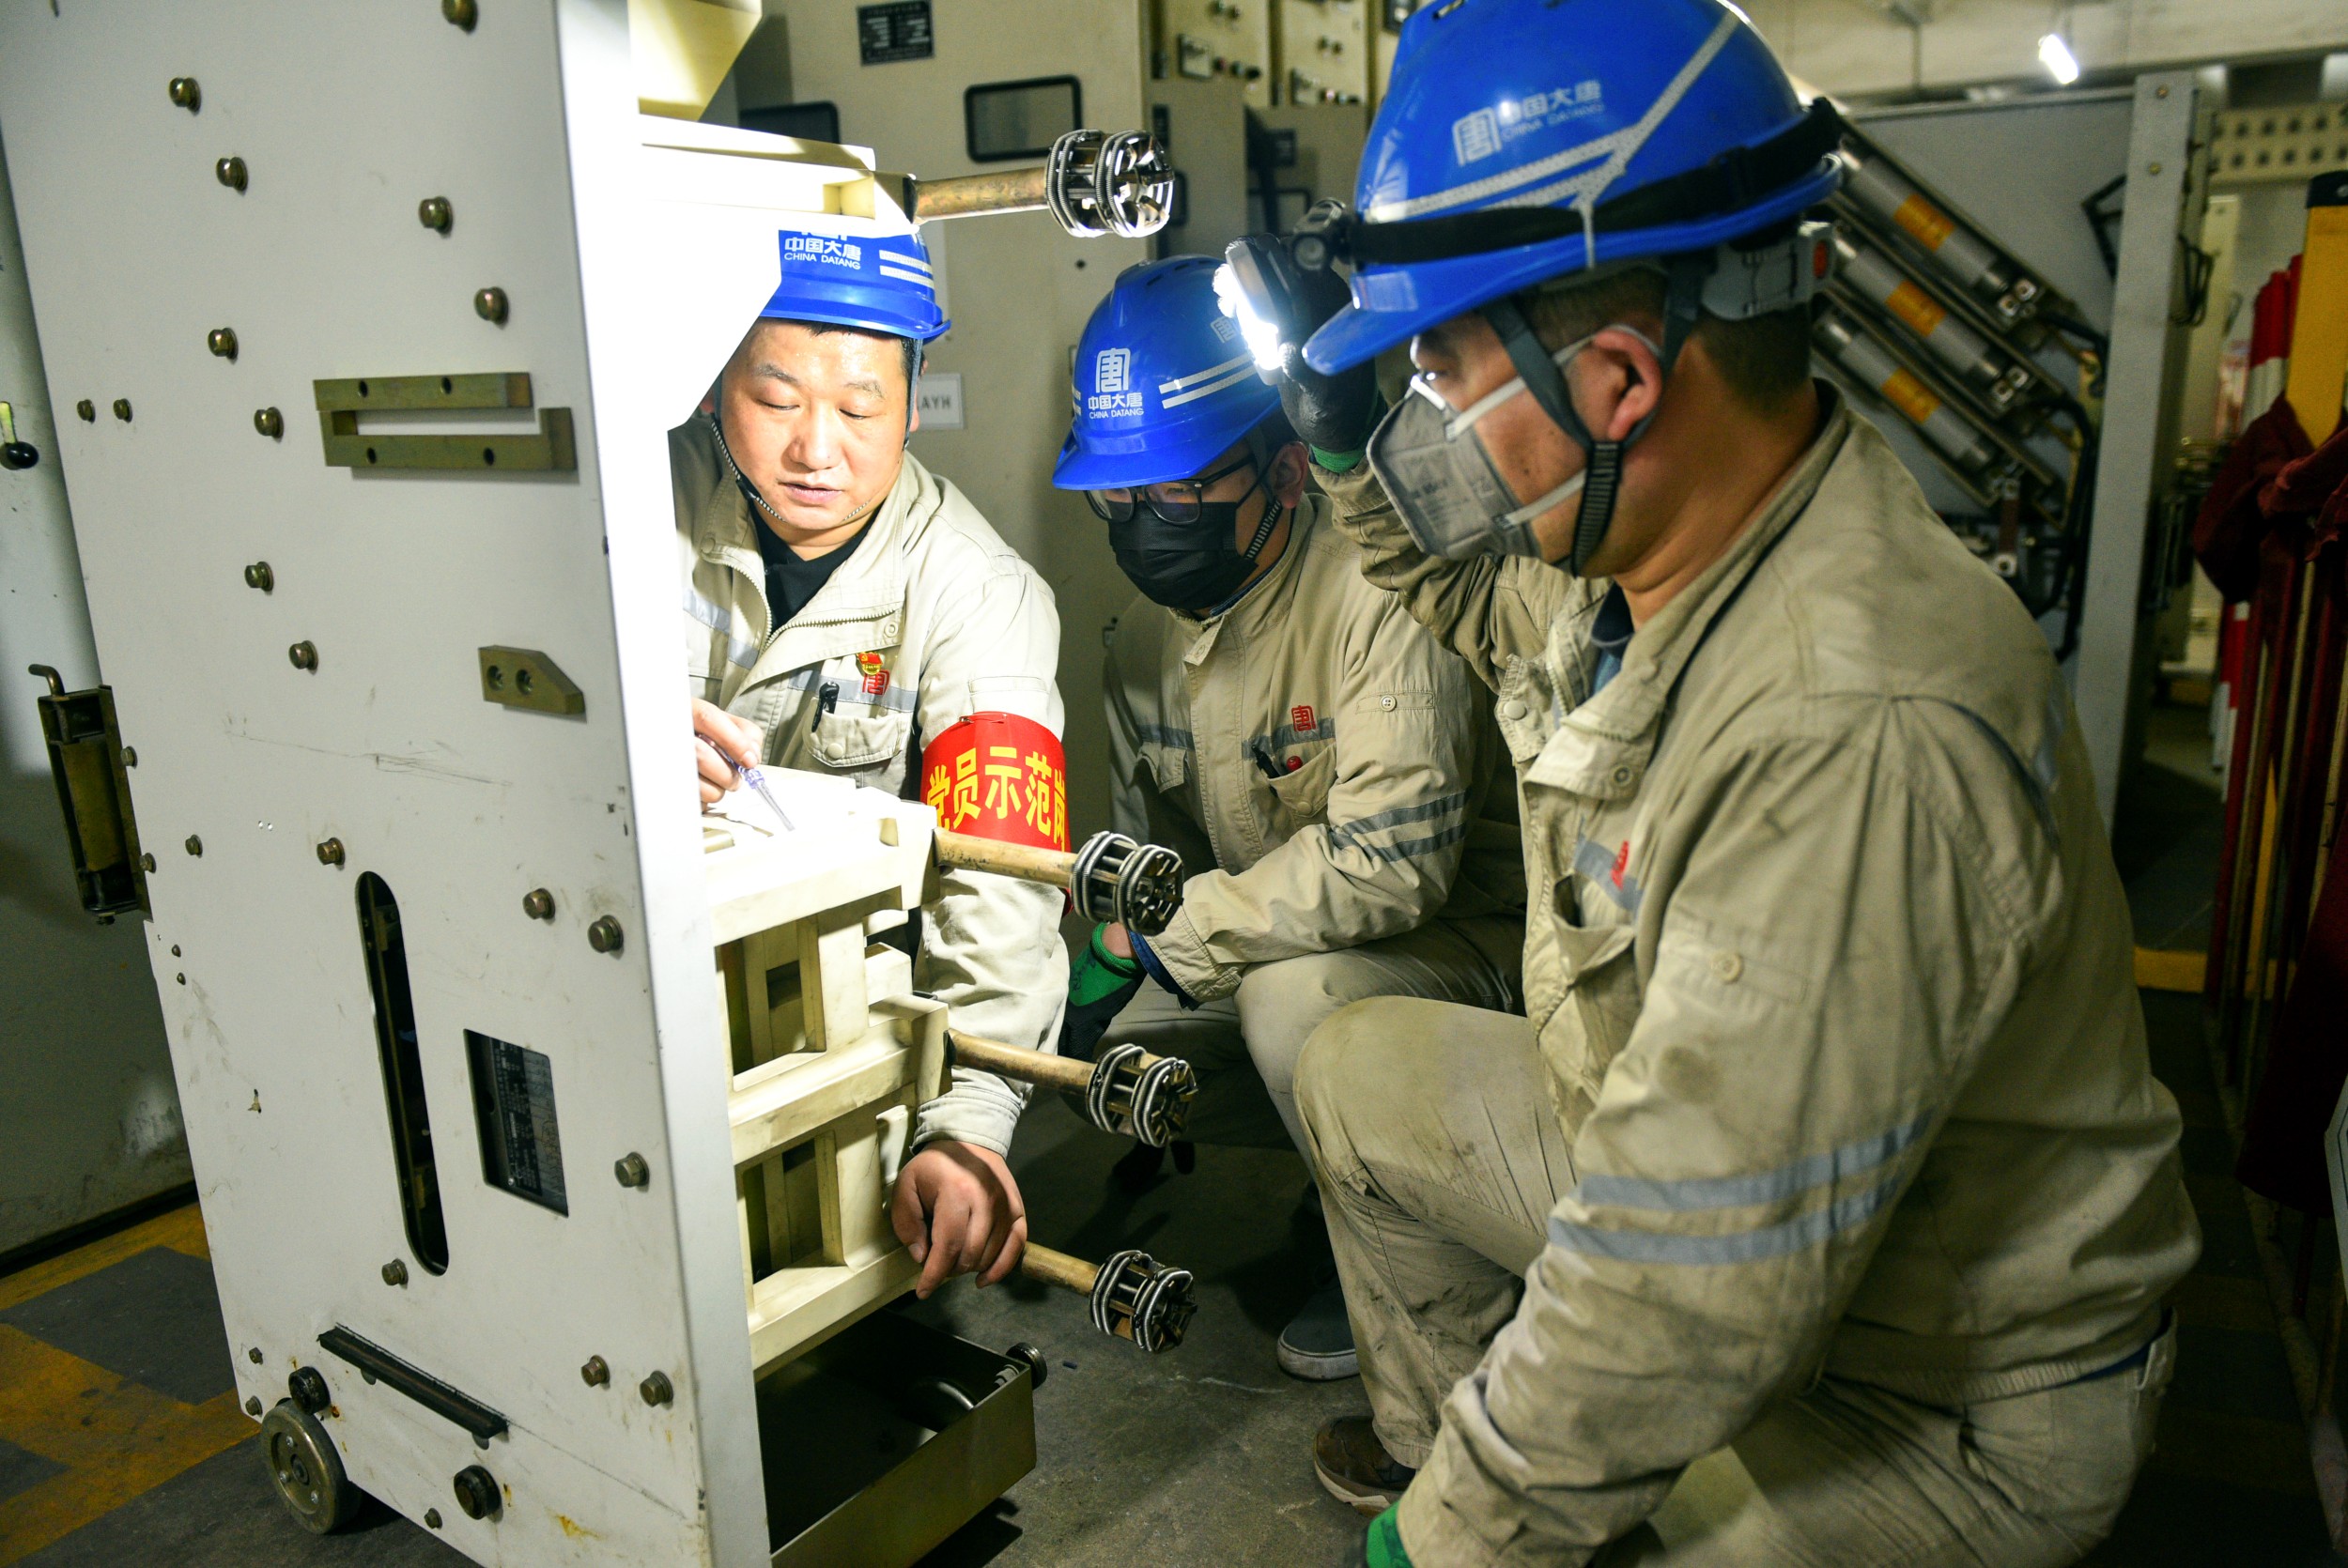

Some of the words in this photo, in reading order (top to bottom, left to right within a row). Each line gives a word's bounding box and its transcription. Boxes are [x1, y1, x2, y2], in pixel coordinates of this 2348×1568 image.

[784, 237, 861, 262] 中国大唐
[784, 252, 817, 262] CHINA
[821, 254, 861, 269] DATANG
[1088, 392, 1143, 410] 中国大唐
[1089, 411, 1109, 420] CHINA
[1111, 407, 1145, 418] DATANG
[926, 746, 1066, 853] 党员示范岗
